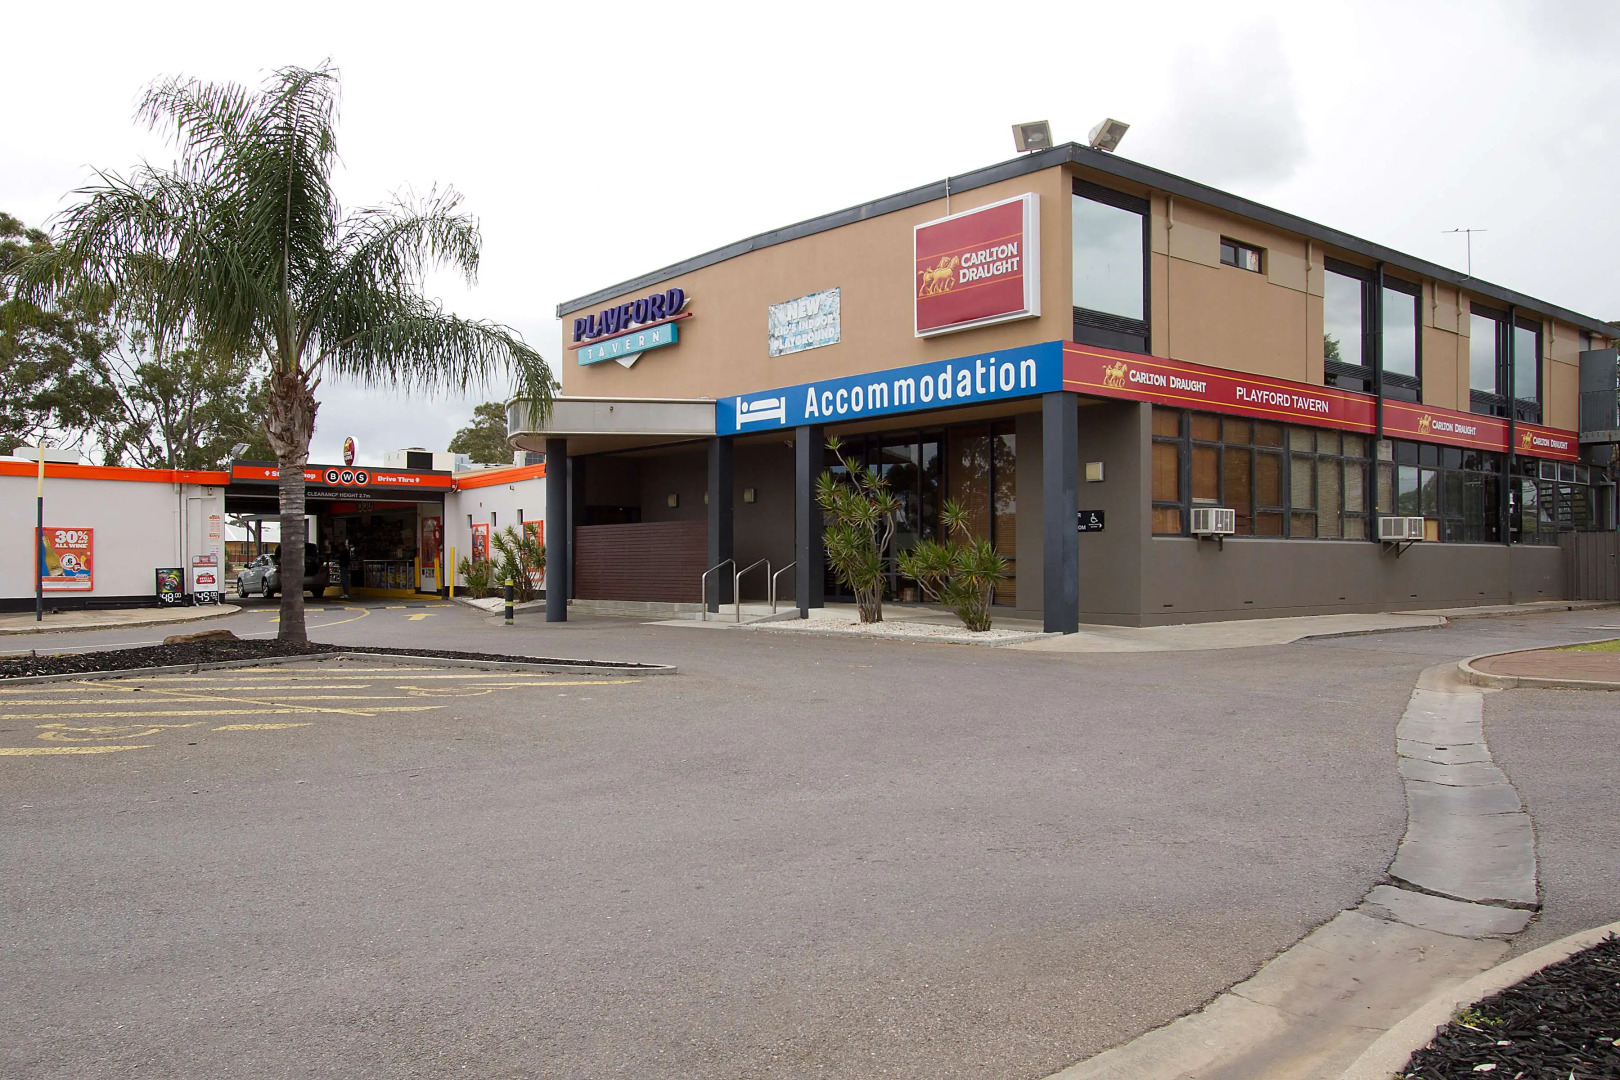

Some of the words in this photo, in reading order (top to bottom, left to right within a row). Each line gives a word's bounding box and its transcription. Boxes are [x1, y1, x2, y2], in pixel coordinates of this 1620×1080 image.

[961, 241, 1018, 268] CARLTON
[959, 257, 1020, 284] DRAUGHT
[573, 288, 684, 342] PLAYFORD
[786, 298, 821, 321] NEW
[587, 330, 660, 360] TAVERN
[773, 327, 835, 350] PLAYGROUND
[804, 357, 1037, 419] Accommodation
[1129, 369, 1167, 387] CARLTON
[1169, 376, 1206, 393] DRAUGHT
[1236, 386, 1291, 407] PLAYFORD
[1292, 395, 1329, 413] TAVERN
[1432, 420, 1454, 432] CARLTON
[1454, 423, 1476, 435] DRAUGHT
[55, 530, 89, 544] 30%
